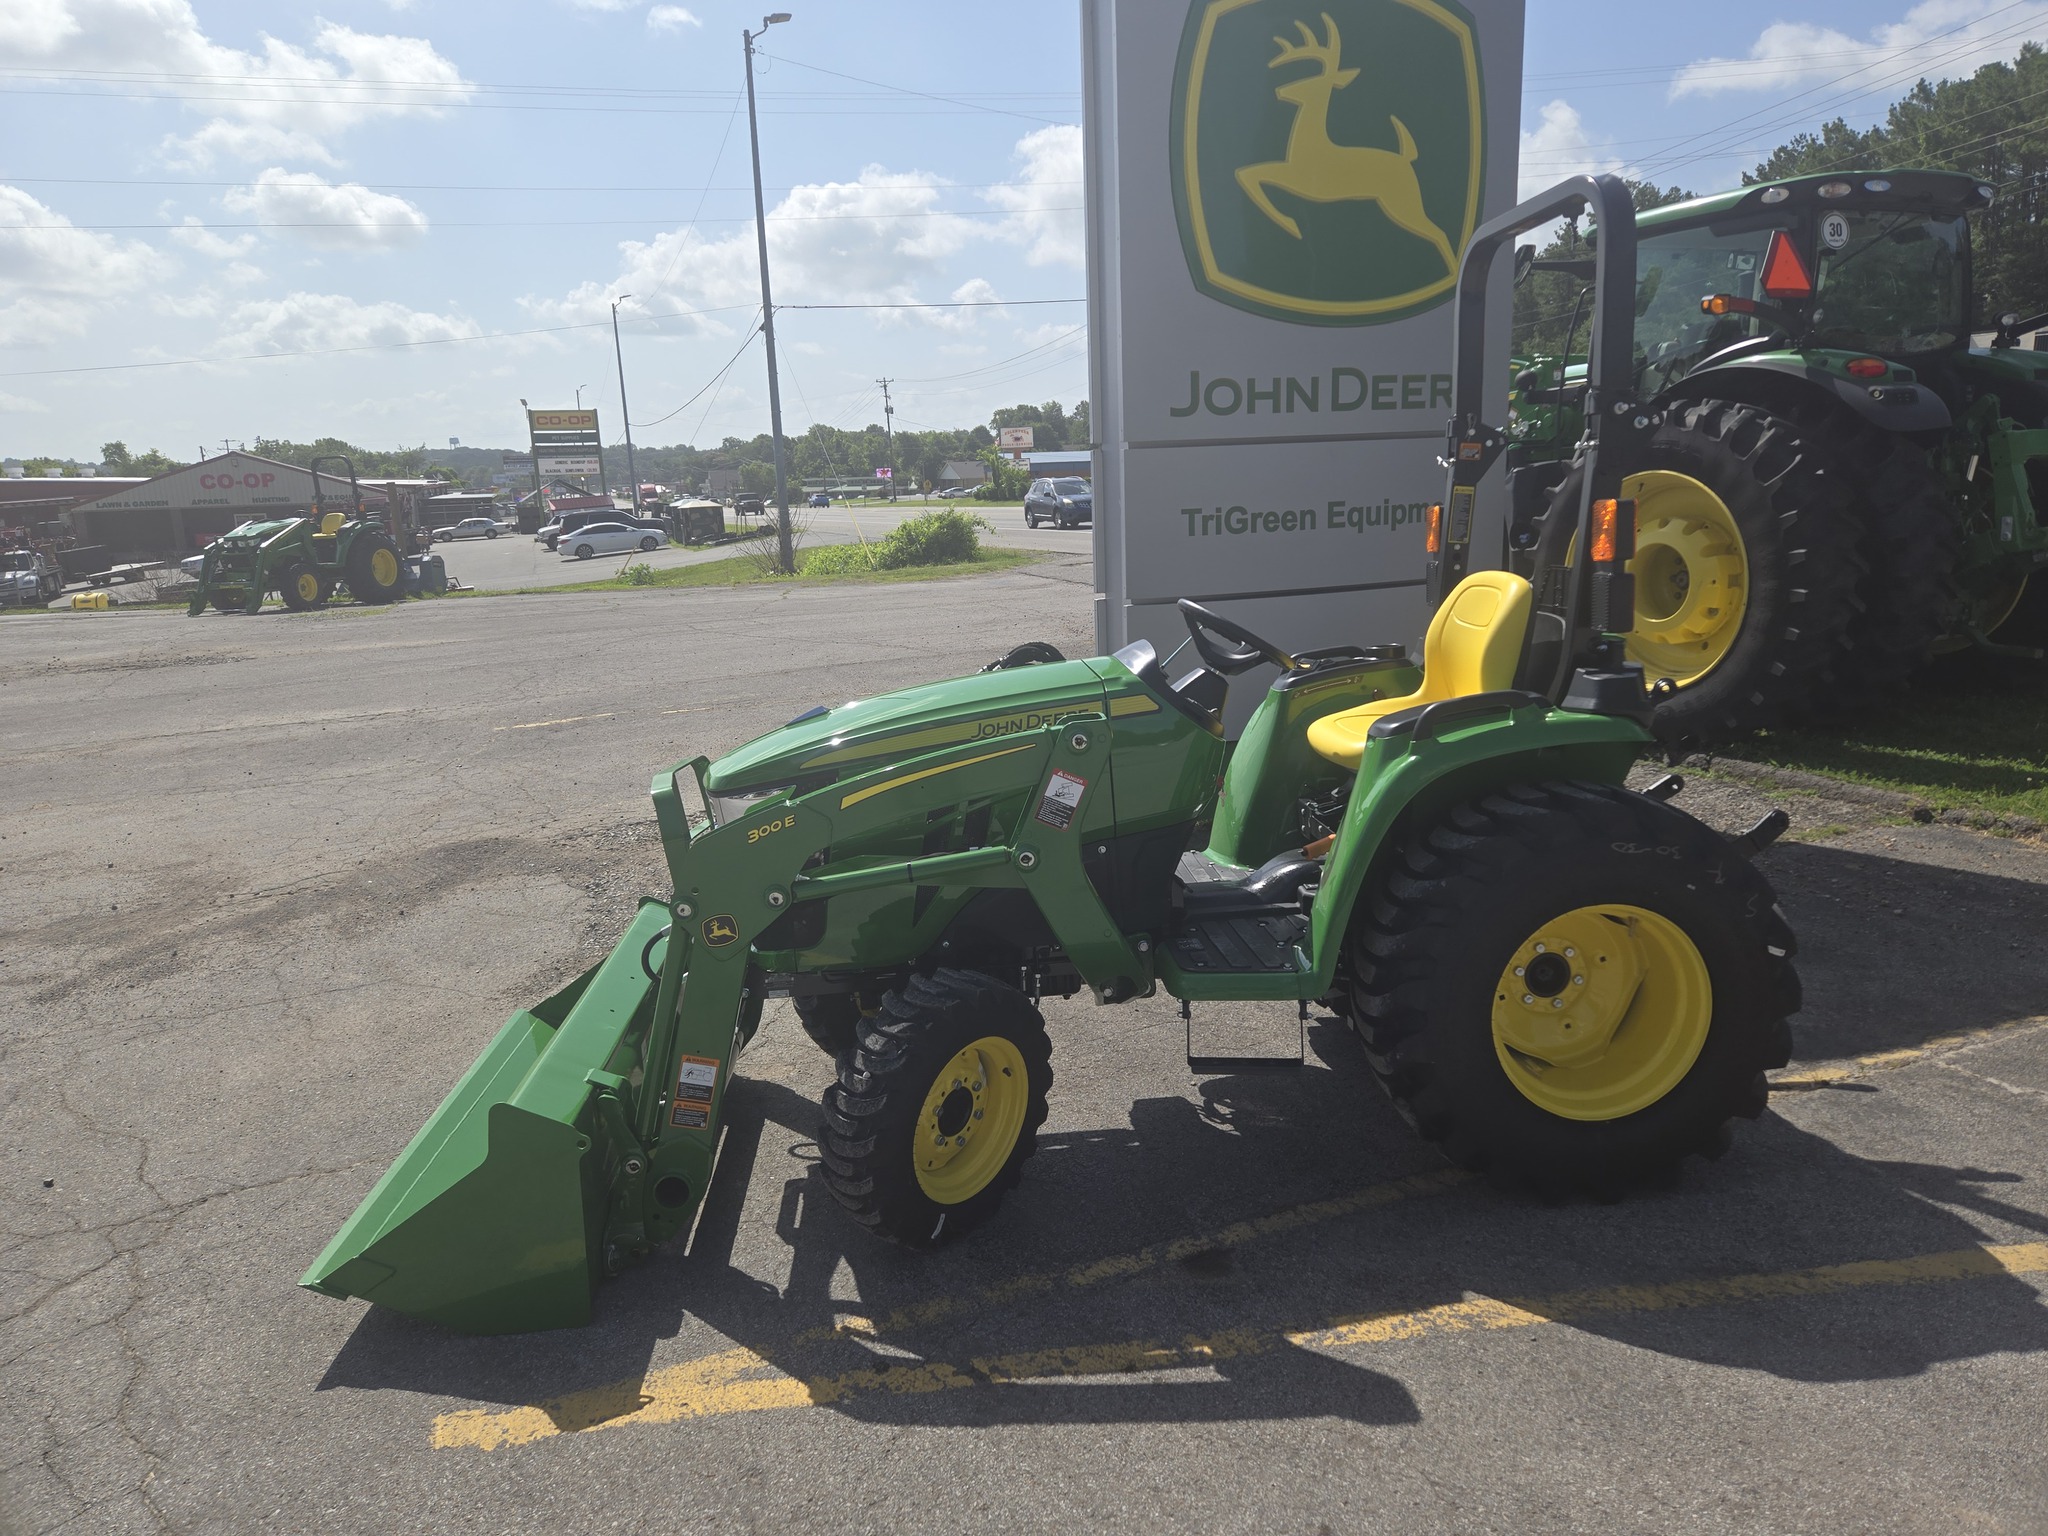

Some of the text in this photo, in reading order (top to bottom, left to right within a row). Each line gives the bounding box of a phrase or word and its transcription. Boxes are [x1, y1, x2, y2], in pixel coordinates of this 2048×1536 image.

[1829, 222, 1842, 237] 30
[1169, 366, 1453, 418] JOHN DEER
[536, 415, 592, 425] CO-OP
[200, 472, 276, 490] CO-OP
[1180, 505, 1317, 537] TriGreen
[1327, 498, 1443, 534] Equipm
[970, 719, 1023, 740] JOHN
[1063, 773, 1084, 784] DANGER
